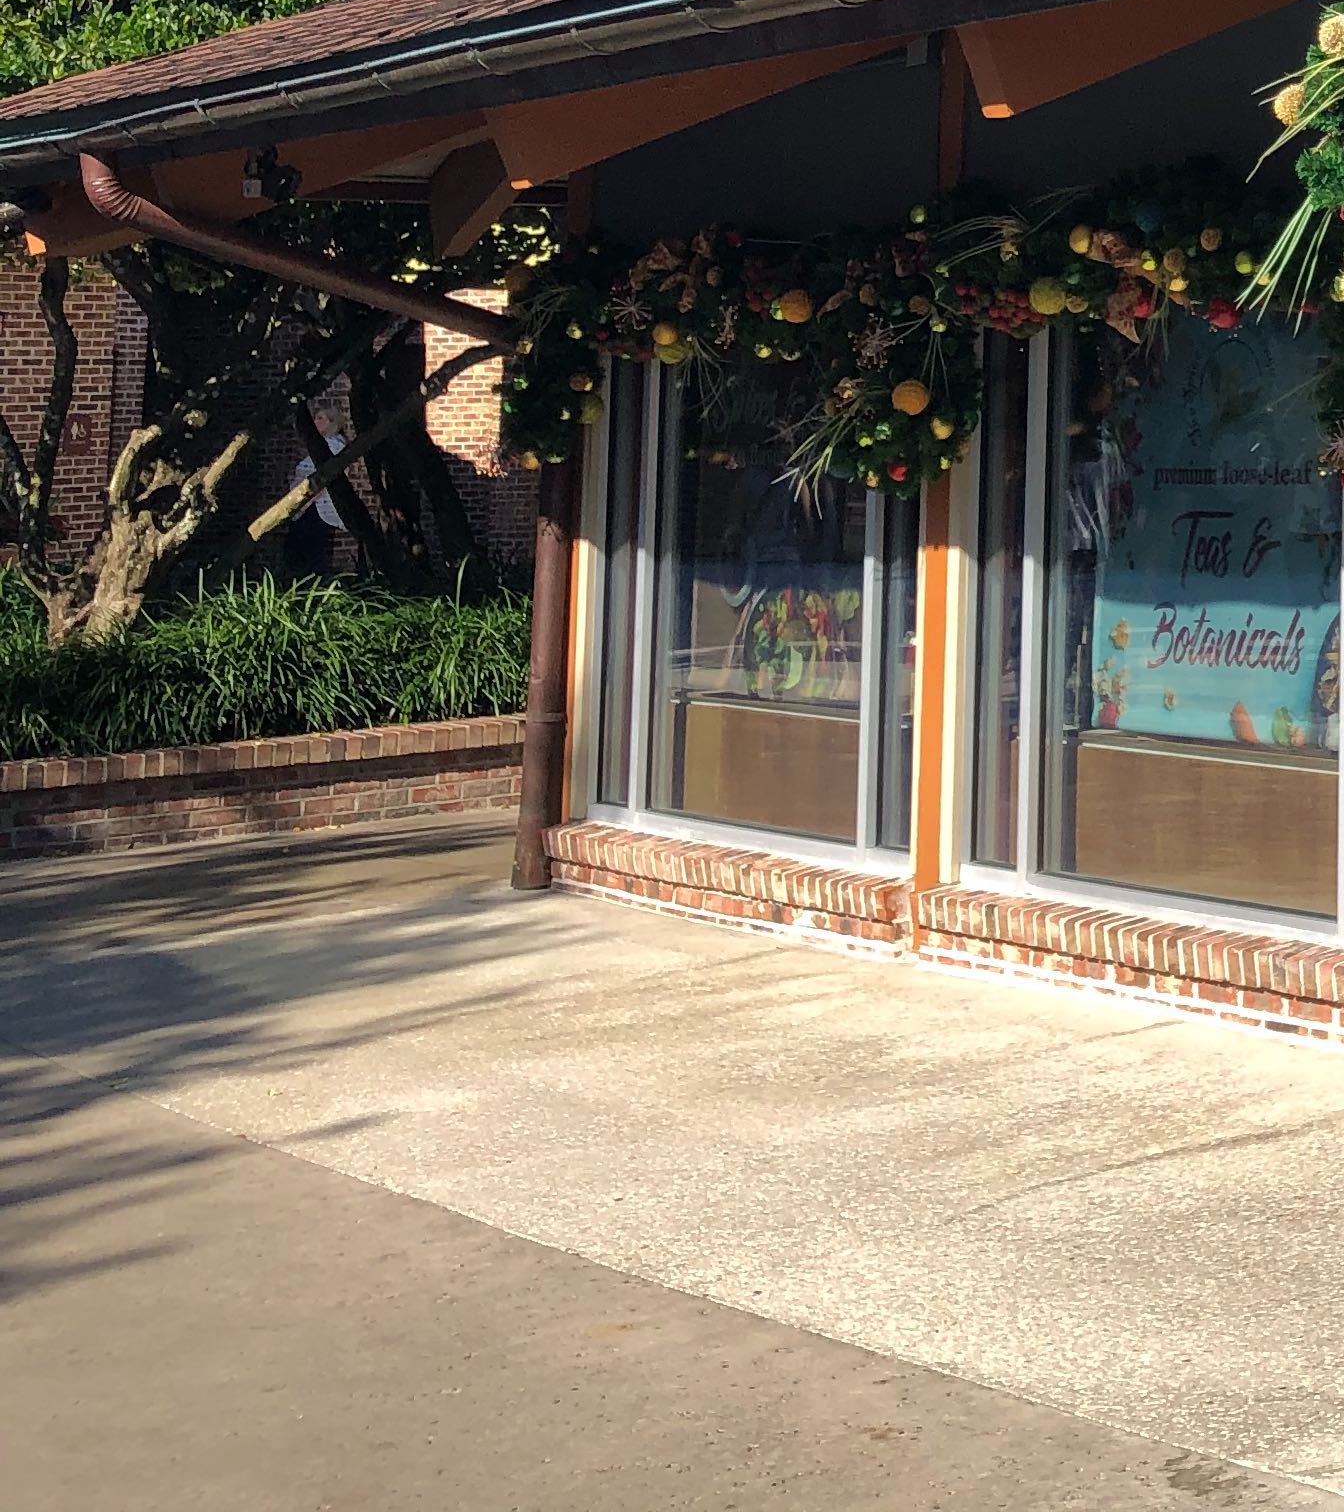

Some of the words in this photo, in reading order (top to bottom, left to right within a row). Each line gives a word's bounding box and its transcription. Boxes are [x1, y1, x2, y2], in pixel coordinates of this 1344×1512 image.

[1171, 510, 1234, 588] Teas
[1243, 516, 1282, 579] &
[1146, 601, 1305, 676] Botanicals
